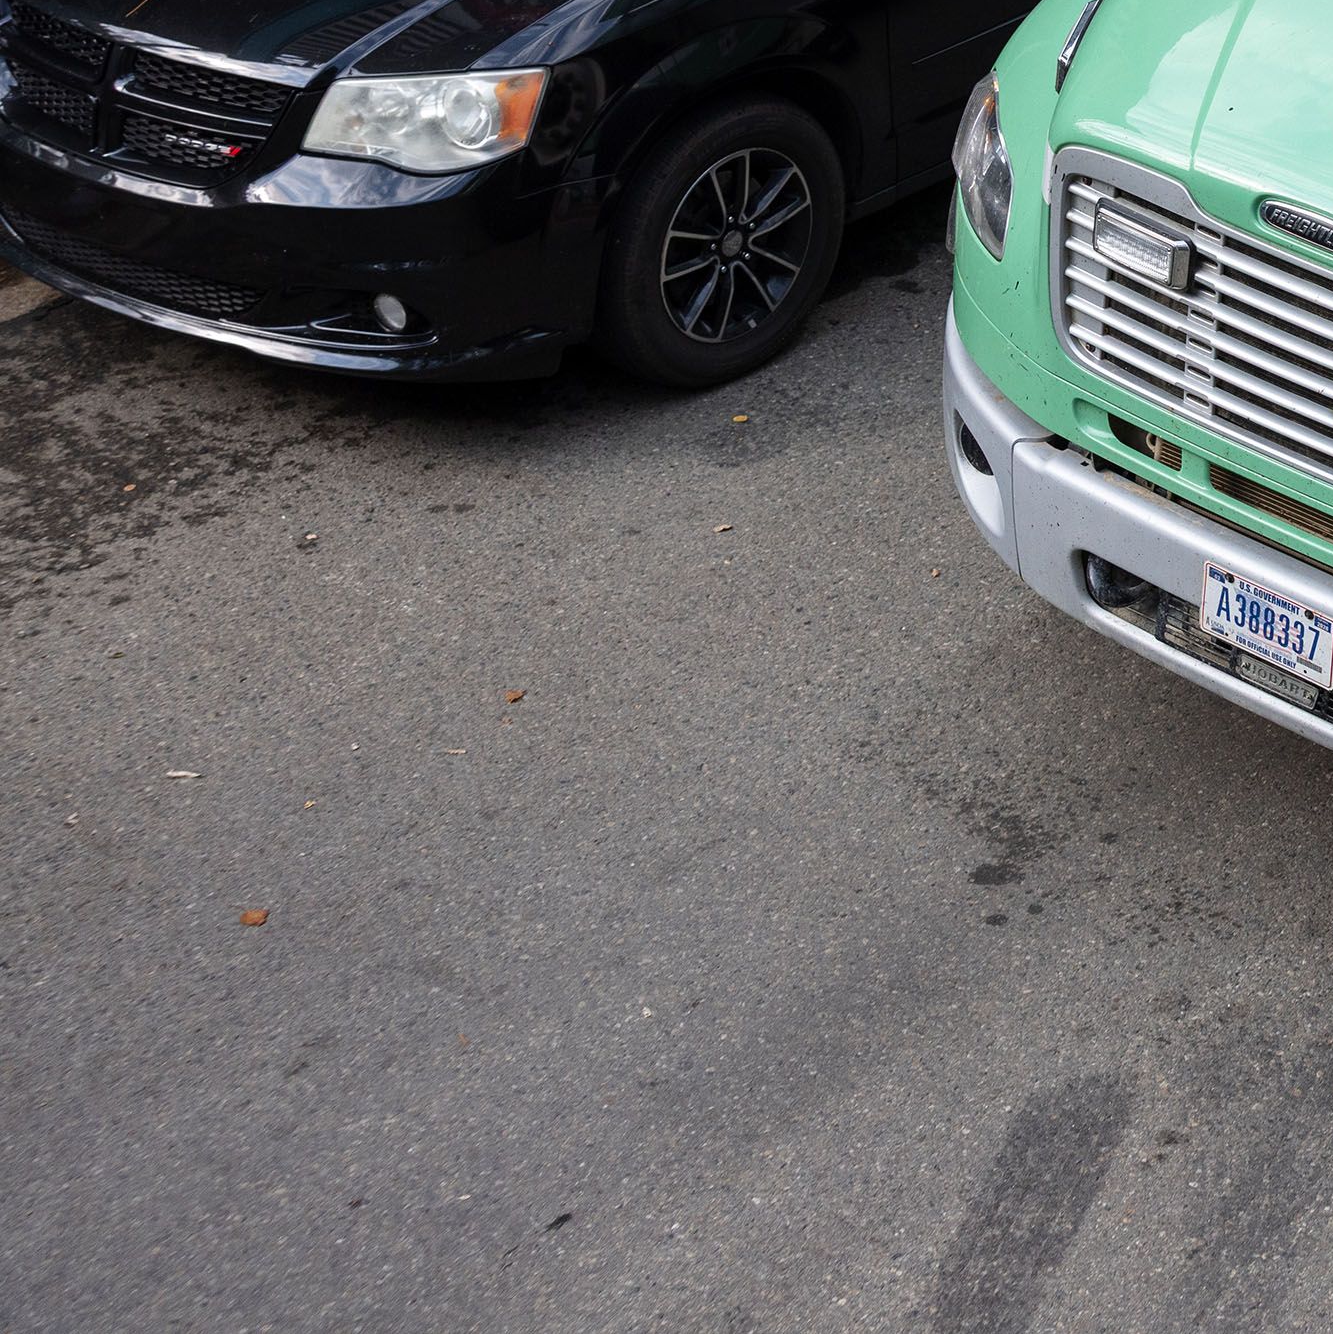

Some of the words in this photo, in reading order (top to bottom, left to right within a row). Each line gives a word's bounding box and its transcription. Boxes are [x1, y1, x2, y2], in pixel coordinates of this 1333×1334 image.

[165, 133, 231, 154] DODGE
[1239, 580, 1253, 595] U.S.
[1253, 587, 1301, 616] GOVERNMENT
[1216, 585, 1320, 661] A388337
[1235, 635, 1247, 646] FOR
[1247, 641, 1271, 658] OFFICIAL
[1271, 652, 1282, 663] USE
[1283, 657, 1297, 669] ONLY
[1246, 662, 1311, 700] HOBART
